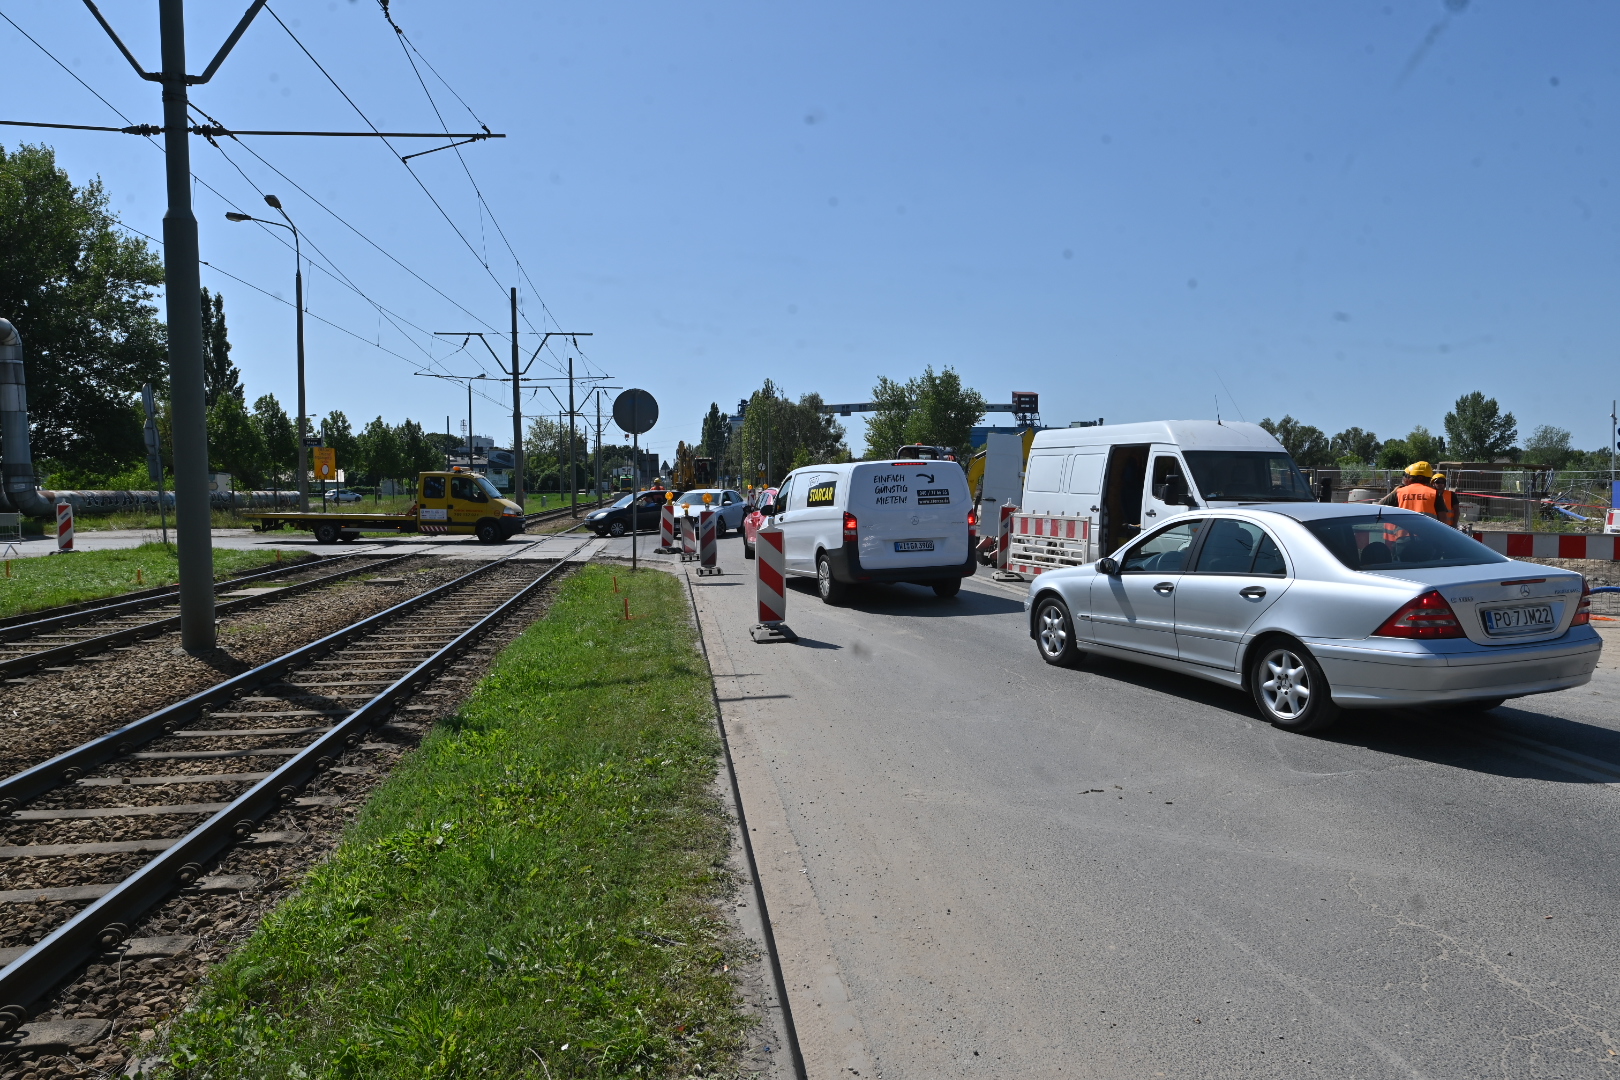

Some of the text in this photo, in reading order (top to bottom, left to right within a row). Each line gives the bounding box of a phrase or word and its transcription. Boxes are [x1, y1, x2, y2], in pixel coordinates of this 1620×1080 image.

[873, 474, 905, 484] EINFACH
[809, 486, 834, 502] STARCAR
[874, 484, 908, 495] GÜNSTIG
[875, 496, 908, 505] MIETEN!
[1402, 493, 1428, 501] ELTEL
[1494, 612, 1511, 628] PO
